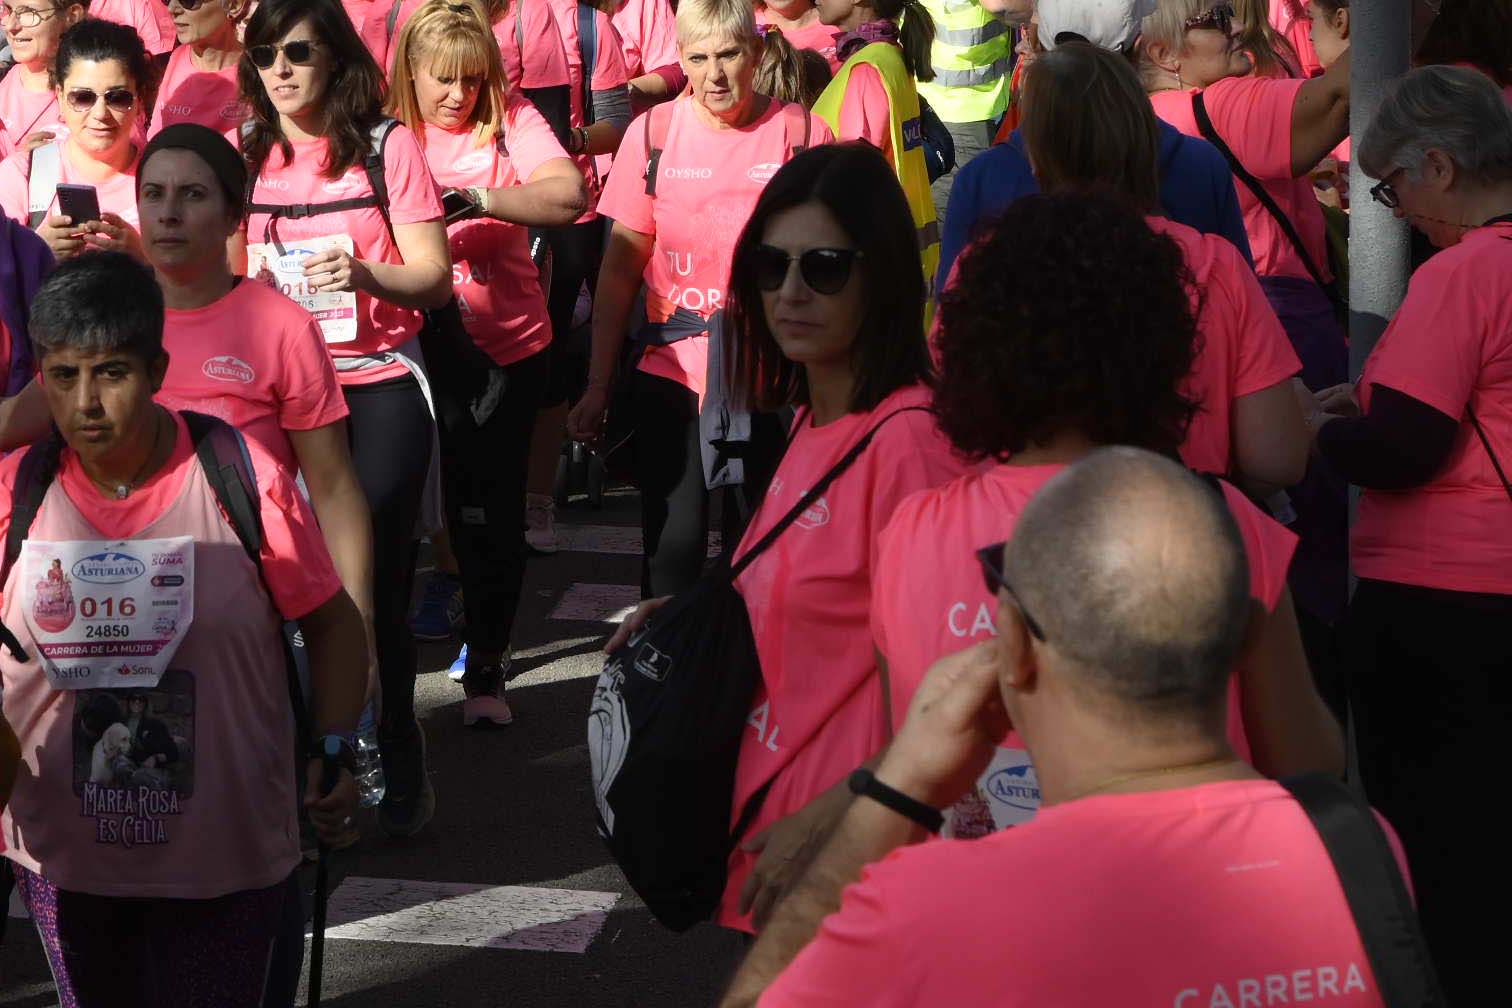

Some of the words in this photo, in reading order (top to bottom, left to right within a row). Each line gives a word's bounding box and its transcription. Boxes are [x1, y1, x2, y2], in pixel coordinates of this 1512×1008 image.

[664, 167, 713, 179] OYSHO
[151, 557, 184, 566] SUMA
[77, 564, 139, 576] ASTURIANA
[80, 597, 136, 618] 016
[86, 625, 129, 638] 24850
[44, 645, 88, 656] CARRERA
[91, 645, 104, 654] DE
[106, 645, 118, 653] LA
[120, 644, 153, 653] MUJER
[84, 783, 134, 817] MAREA
[139, 786, 178, 820] ROSA
[99, 818, 117, 842] ES
[122, 815, 165, 848] CELIA
[1174, 962, 1366, 1008] CARRERA
